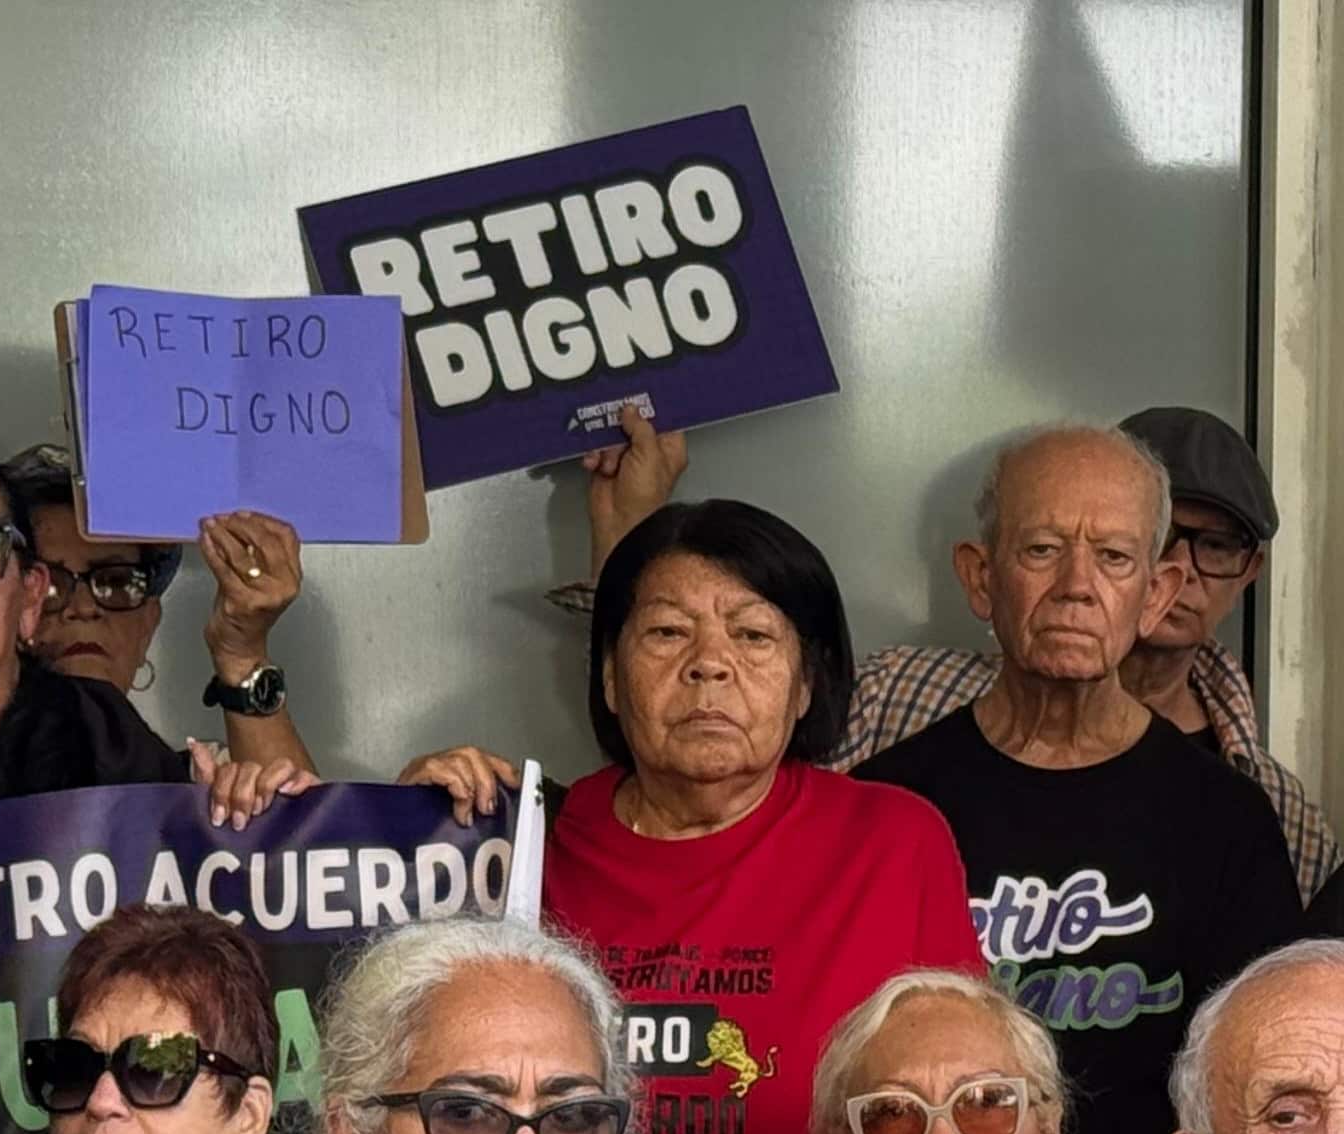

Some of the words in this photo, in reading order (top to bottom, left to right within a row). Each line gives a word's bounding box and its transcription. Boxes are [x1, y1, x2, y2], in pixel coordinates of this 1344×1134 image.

[349, 164, 743, 316] RETIRO
[109, 304, 328, 361] RETIRO
[416, 264, 739, 408] DIGNO
[175, 386, 350, 436] DIGNO
[144, 838, 511, 932] ACUERDO
